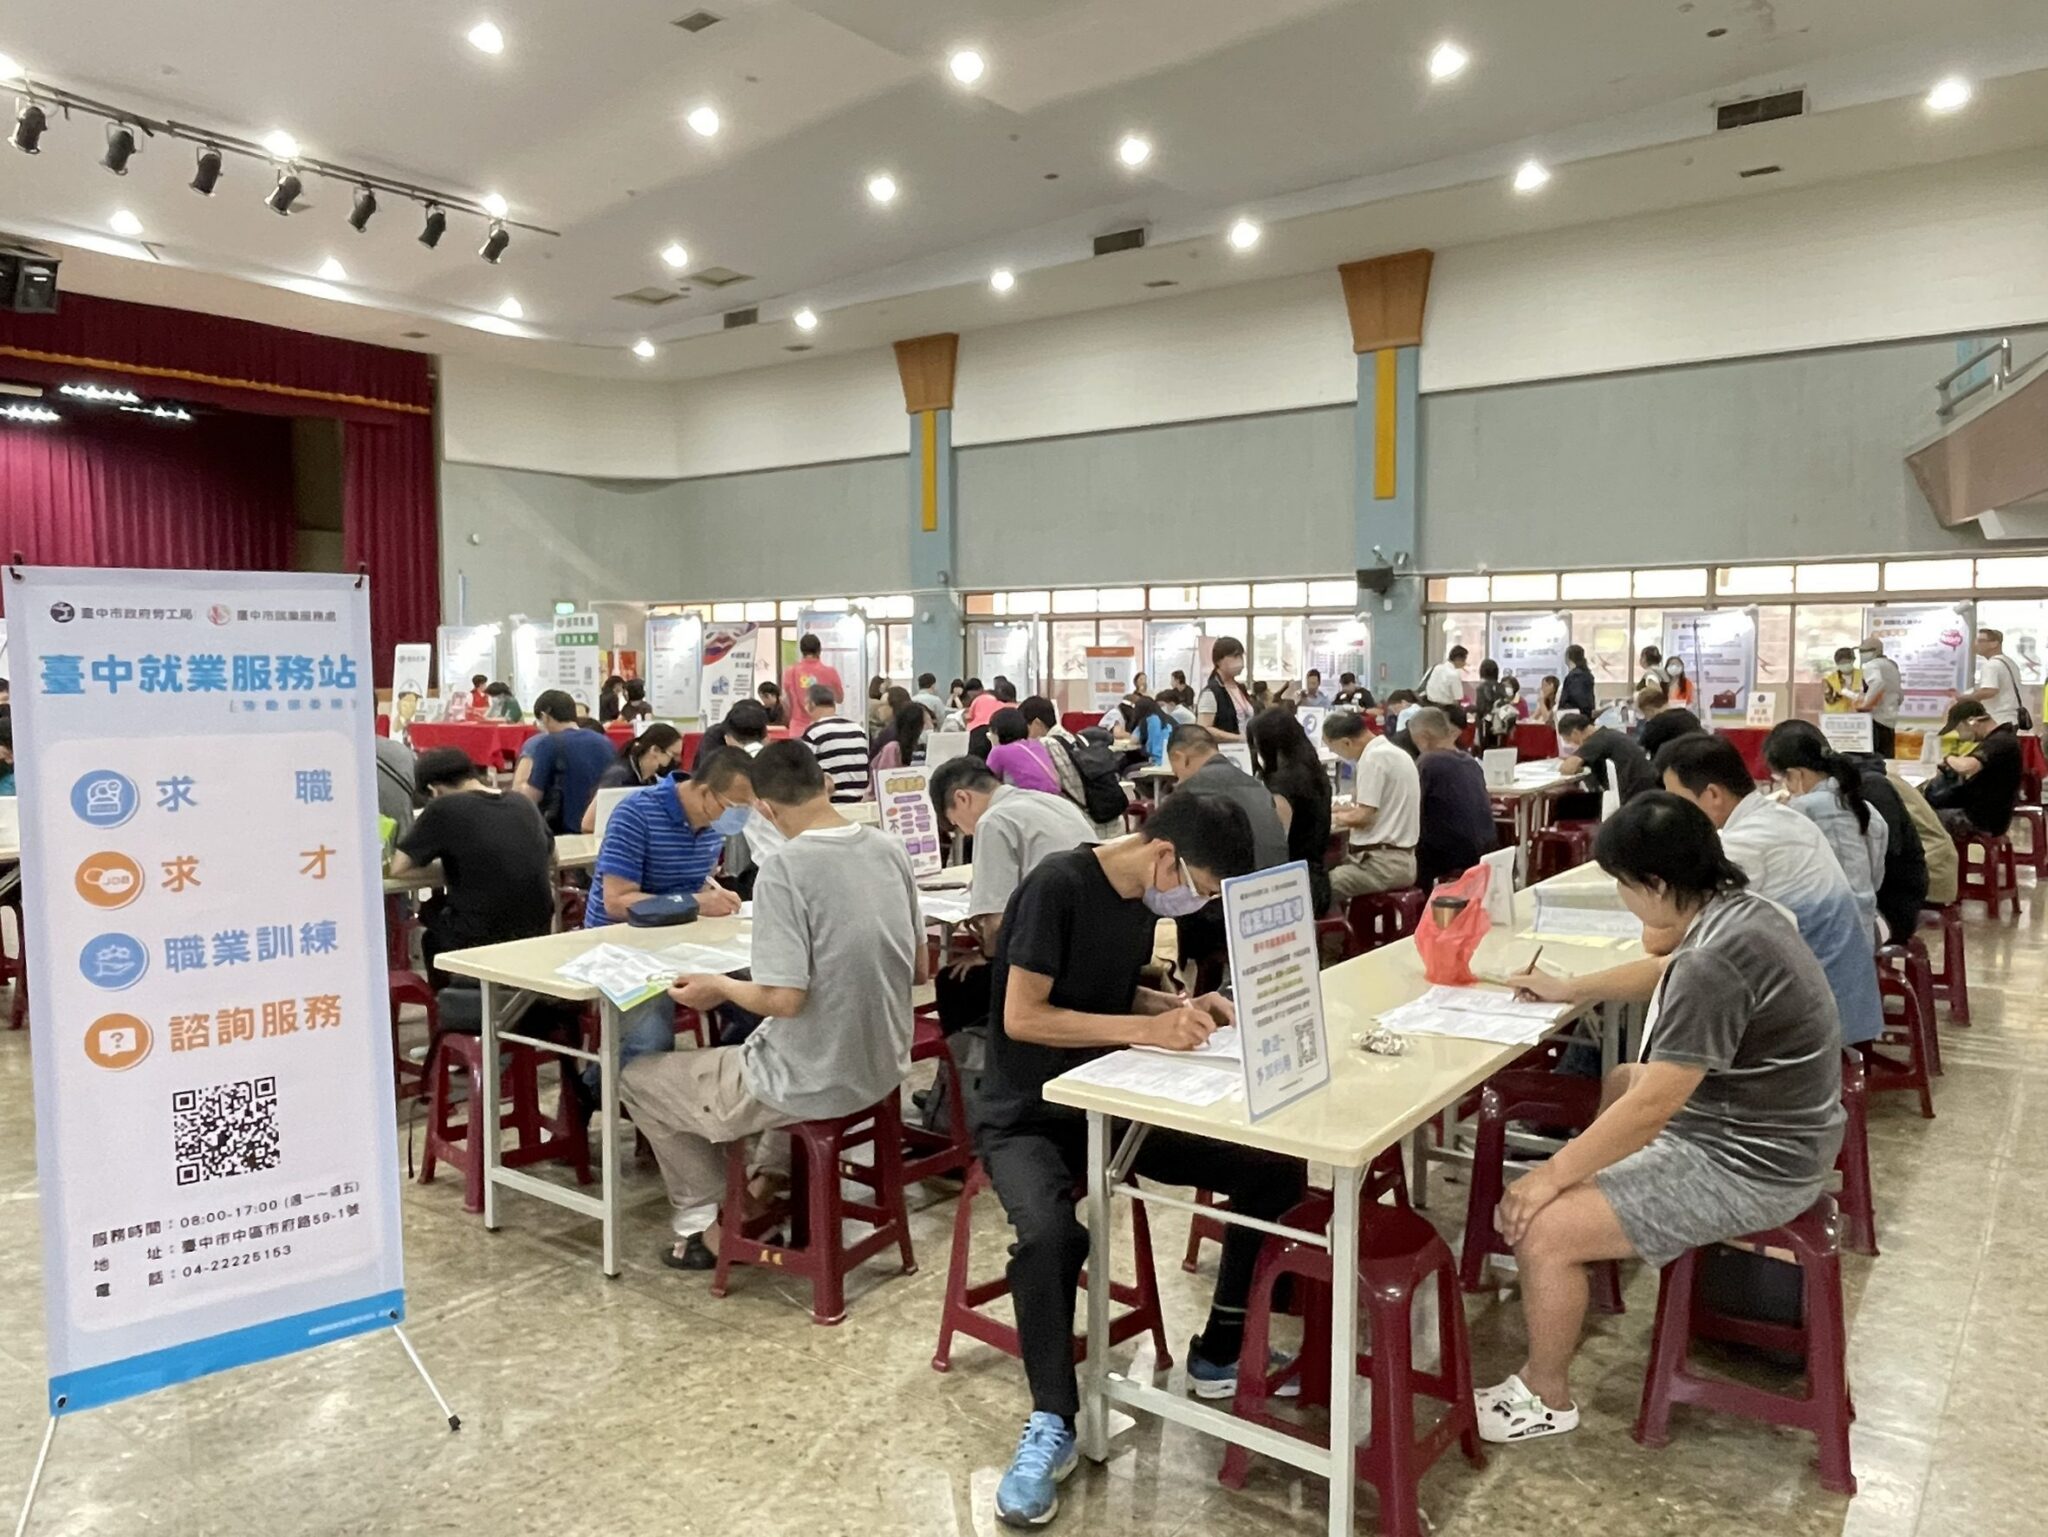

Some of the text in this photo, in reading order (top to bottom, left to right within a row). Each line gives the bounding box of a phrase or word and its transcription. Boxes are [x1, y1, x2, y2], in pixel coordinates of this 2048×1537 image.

[81, 605, 193, 622] 臺中市政府勞工局
[39, 653, 358, 696] 臺中就業服務站
[164, 920, 339, 974] 職業訓練
[168, 994, 342, 1053] 諮詢服務
